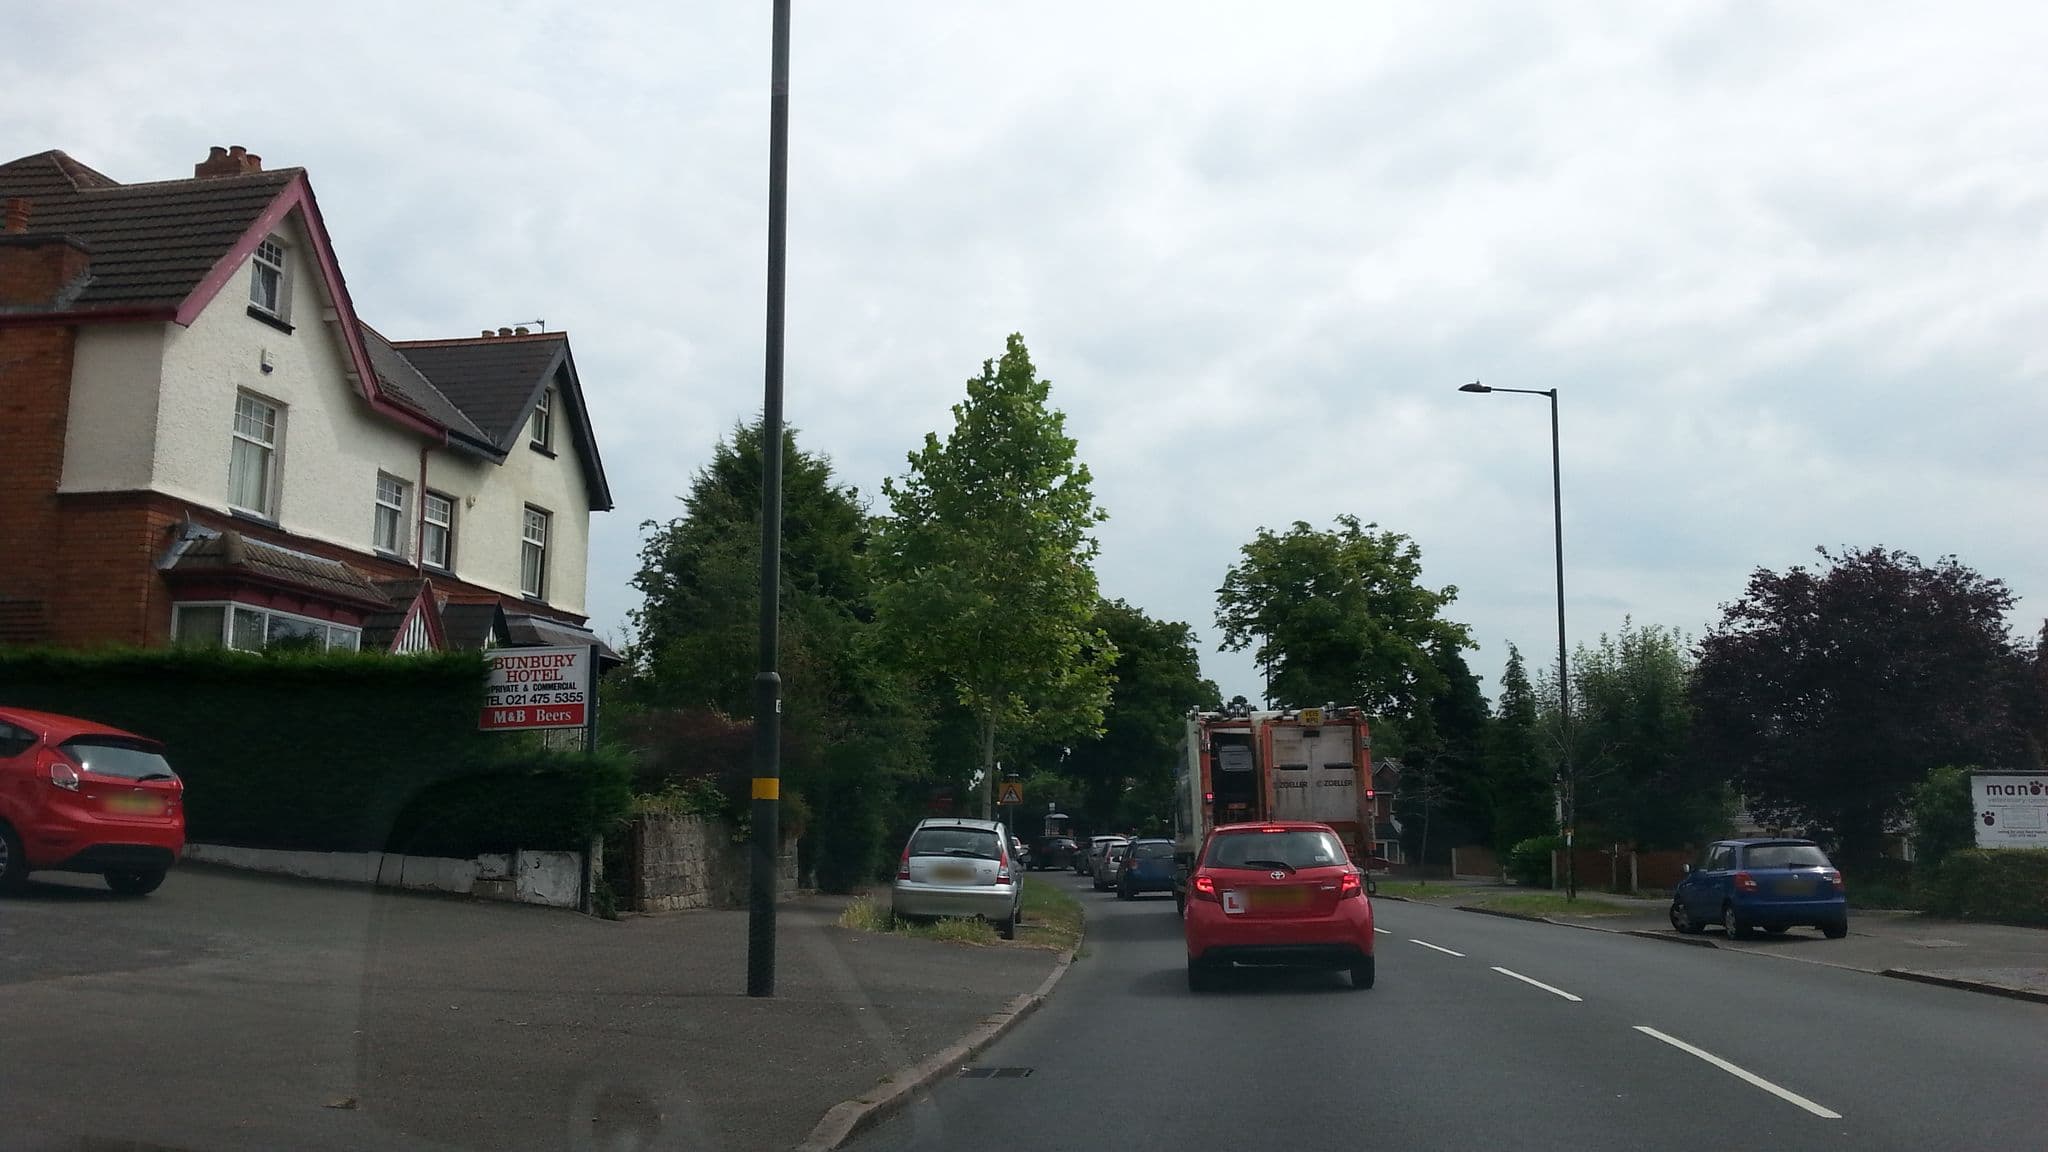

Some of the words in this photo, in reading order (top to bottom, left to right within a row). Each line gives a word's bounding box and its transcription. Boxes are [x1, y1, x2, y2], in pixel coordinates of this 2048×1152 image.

[494, 654, 577, 670] BUNBURY
[505, 669, 563, 683] HOTEL
[490, 684, 519, 693] PRIVATE
[533, 682, 577, 691] COMMERCIAL
[506, 694, 526, 705] 021
[530, 693, 550, 703] 475
[555, 692, 584, 703] 5355
[493, 709, 526, 724] M&B
[536, 709, 572, 721] Beers
[1324, 779, 1353, 787] ZOELLER
[534, 857, 540, 869] 3
[1228, 896, 1240, 909] L
